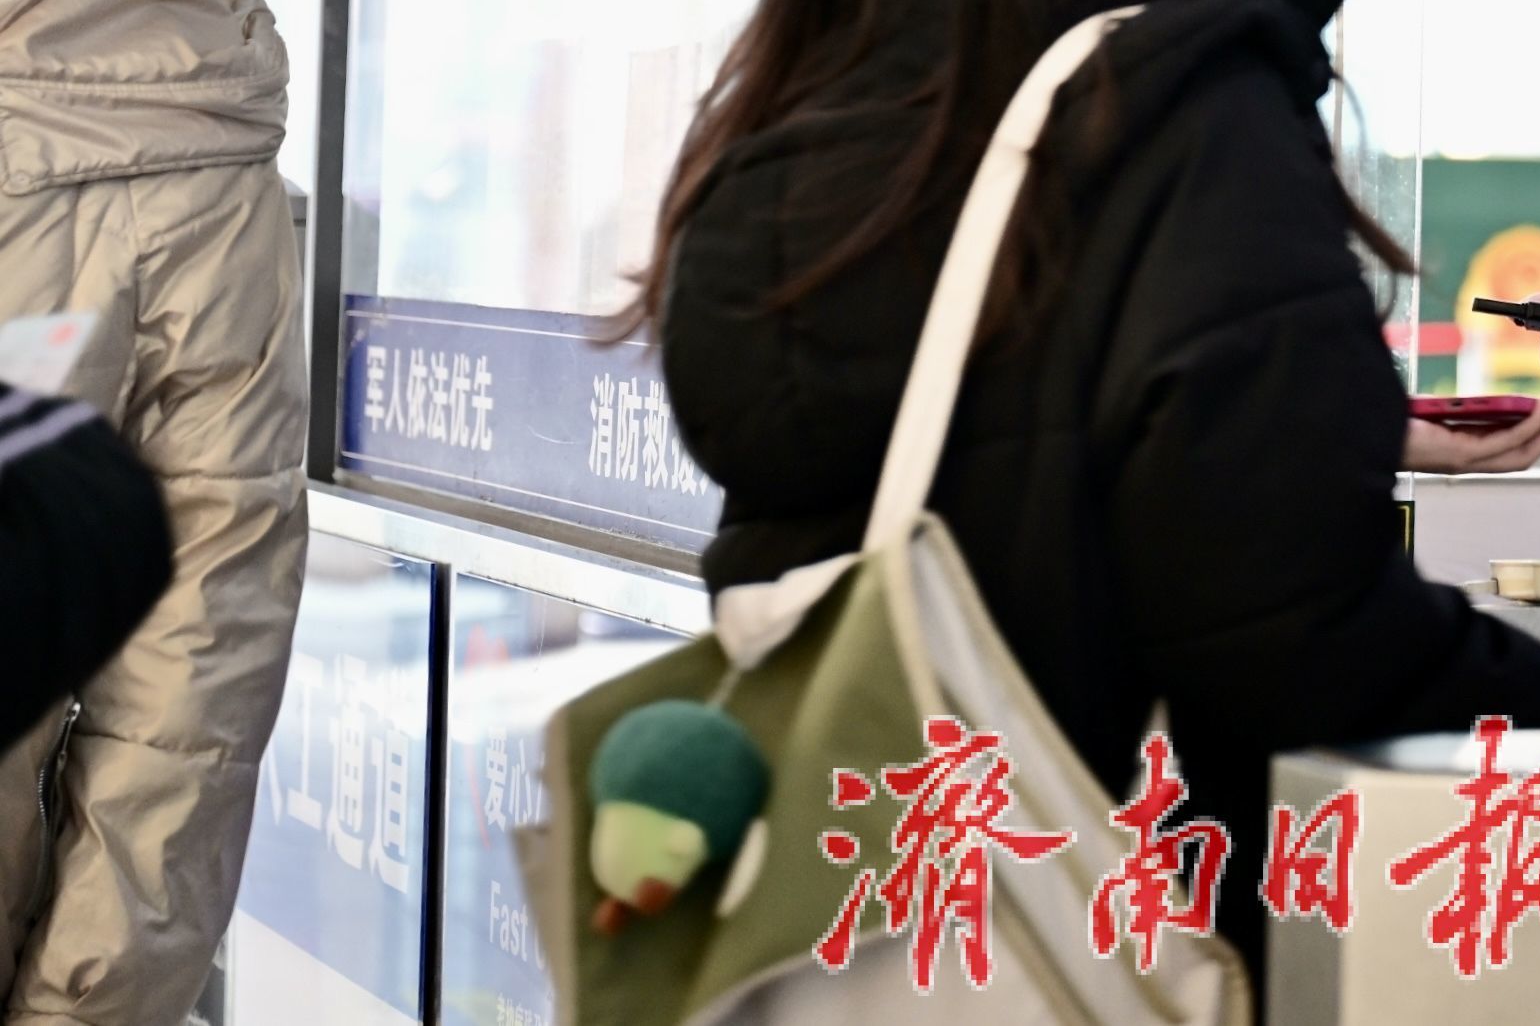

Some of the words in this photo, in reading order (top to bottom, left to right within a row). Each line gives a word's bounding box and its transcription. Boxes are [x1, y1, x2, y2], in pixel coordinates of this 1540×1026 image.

[365, 345, 493, 451] 军人依法优先
[490, 879, 528, 963] Fast
